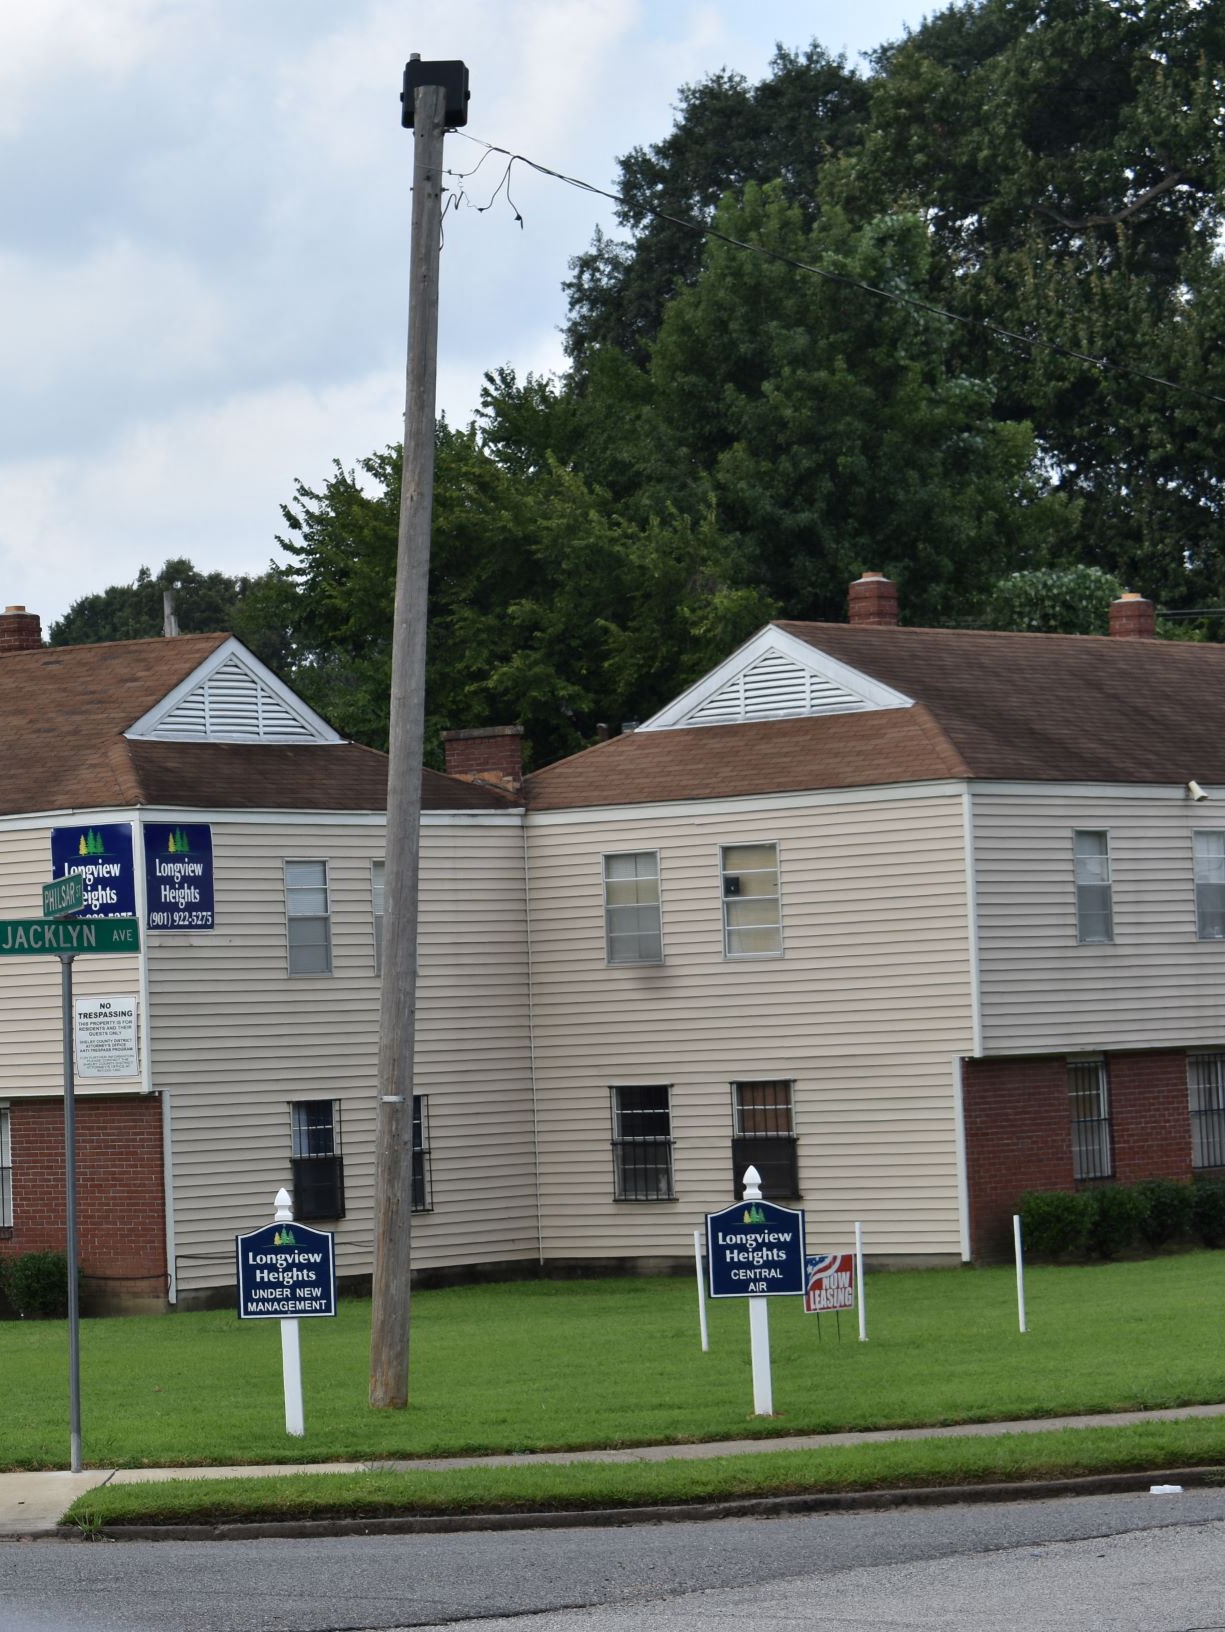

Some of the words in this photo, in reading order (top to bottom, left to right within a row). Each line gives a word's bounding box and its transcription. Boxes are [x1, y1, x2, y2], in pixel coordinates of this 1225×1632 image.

[155, 858, 204, 883] Longview
[44, 882, 75, 913] PHILSAR
[76, 885, 81, 898] ST
[82, 885, 117, 911] eights
[161, 884, 200, 909] Heights
[149, 912, 172, 926] (901)
[173, 911, 212, 925] 922-5275
[2, 924, 96, 949] JACKLYN
[112, 929, 133, 942] AVE
[78, 1010, 133, 1019] TRESPASSING
[99, 1002, 112, 1010] NO
[718, 1229, 792, 1248] Longview
[248, 1249, 323, 1268] Longview
[725, 1247, 787, 1266] Heights
[255, 1267, 316, 1286] Heights
[730, 1268, 783, 1280] CENTRAL
[822, 1271, 851, 1289] NOW
[251, 1288, 291, 1299] UNDER
[296, 1287, 322, 1298] NEW
[748, 1282, 767, 1292] AIR
[247, 1300, 327, 1312] MANAGEMENT
[809, 1287, 853, 1310] LEASING
